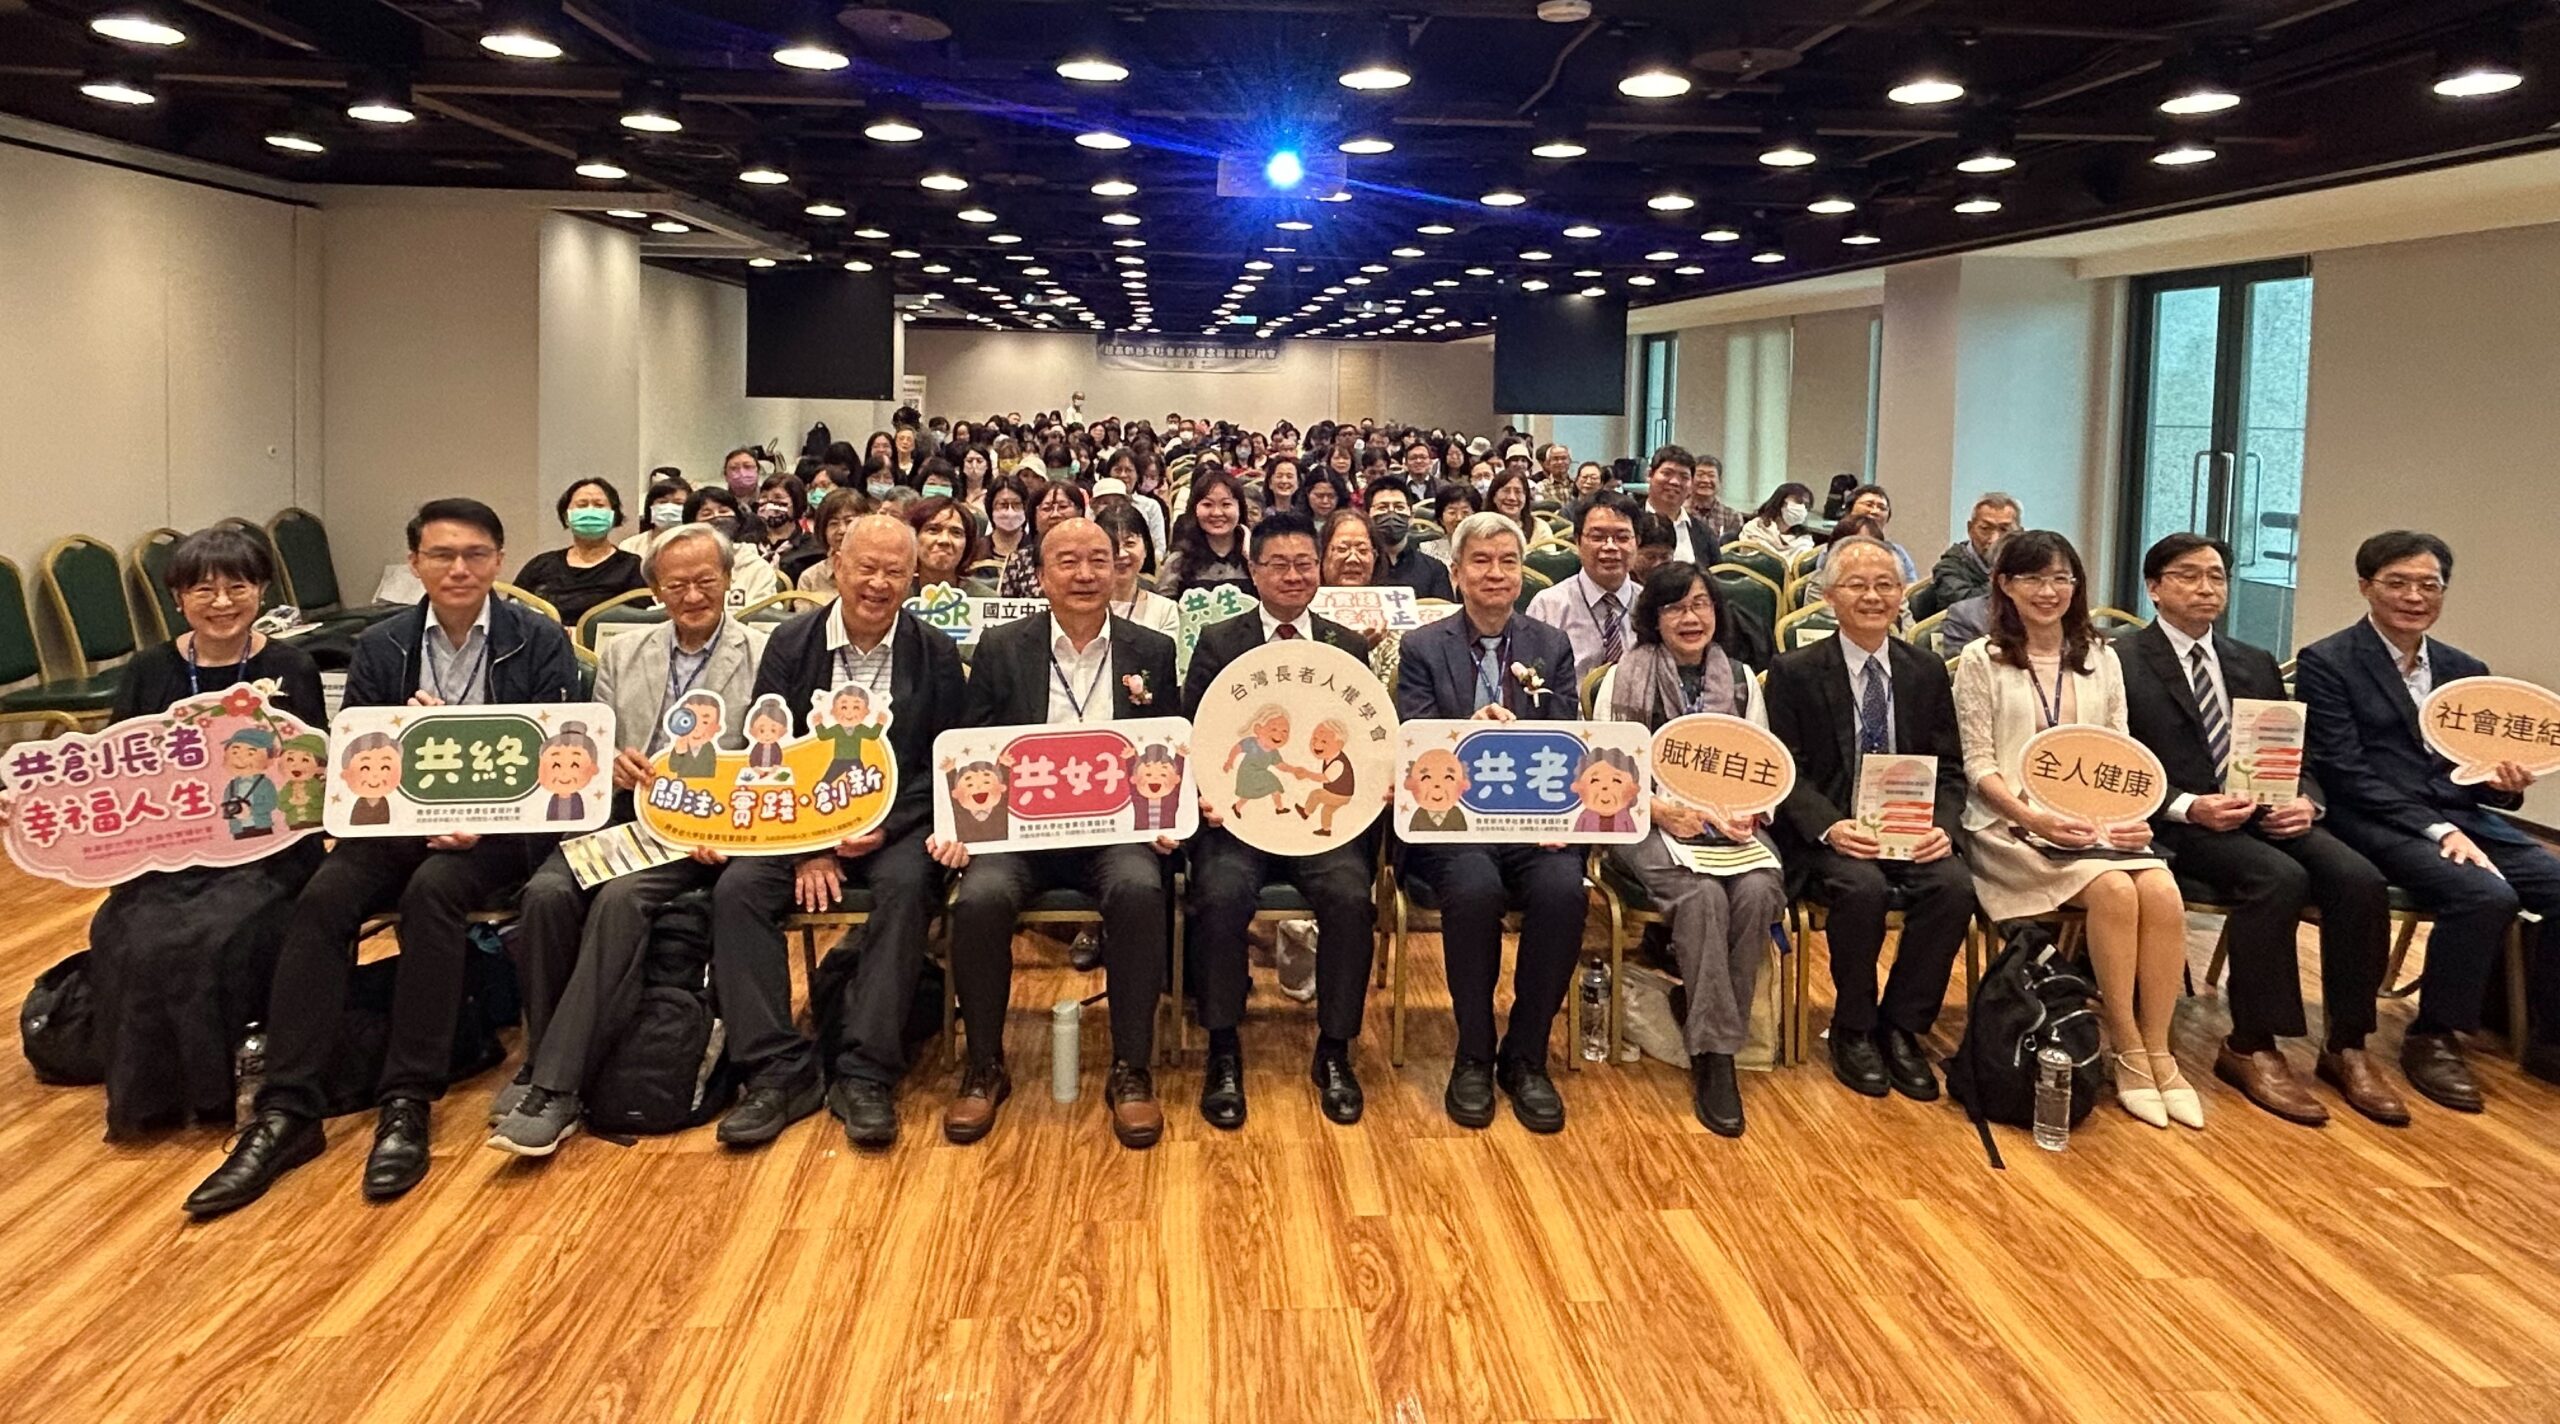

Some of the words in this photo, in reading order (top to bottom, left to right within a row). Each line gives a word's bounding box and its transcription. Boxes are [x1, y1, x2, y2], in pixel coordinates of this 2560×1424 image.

[1184, 589, 1242, 622] 共生
[1385, 590, 1416, 626] 中正
[1231, 665, 1387, 742] 台灣長者人權學會
[11, 726, 204, 790] 共創長者
[415, 735, 529, 789] 共終
[1013, 752, 1125, 806] 共好
[1473, 745, 1568, 802] 共老
[1660, 738, 1779, 787] 賦權自主
[2032, 750, 2154, 798] 全人健康
[23, 782, 211, 843] 幸福人生
